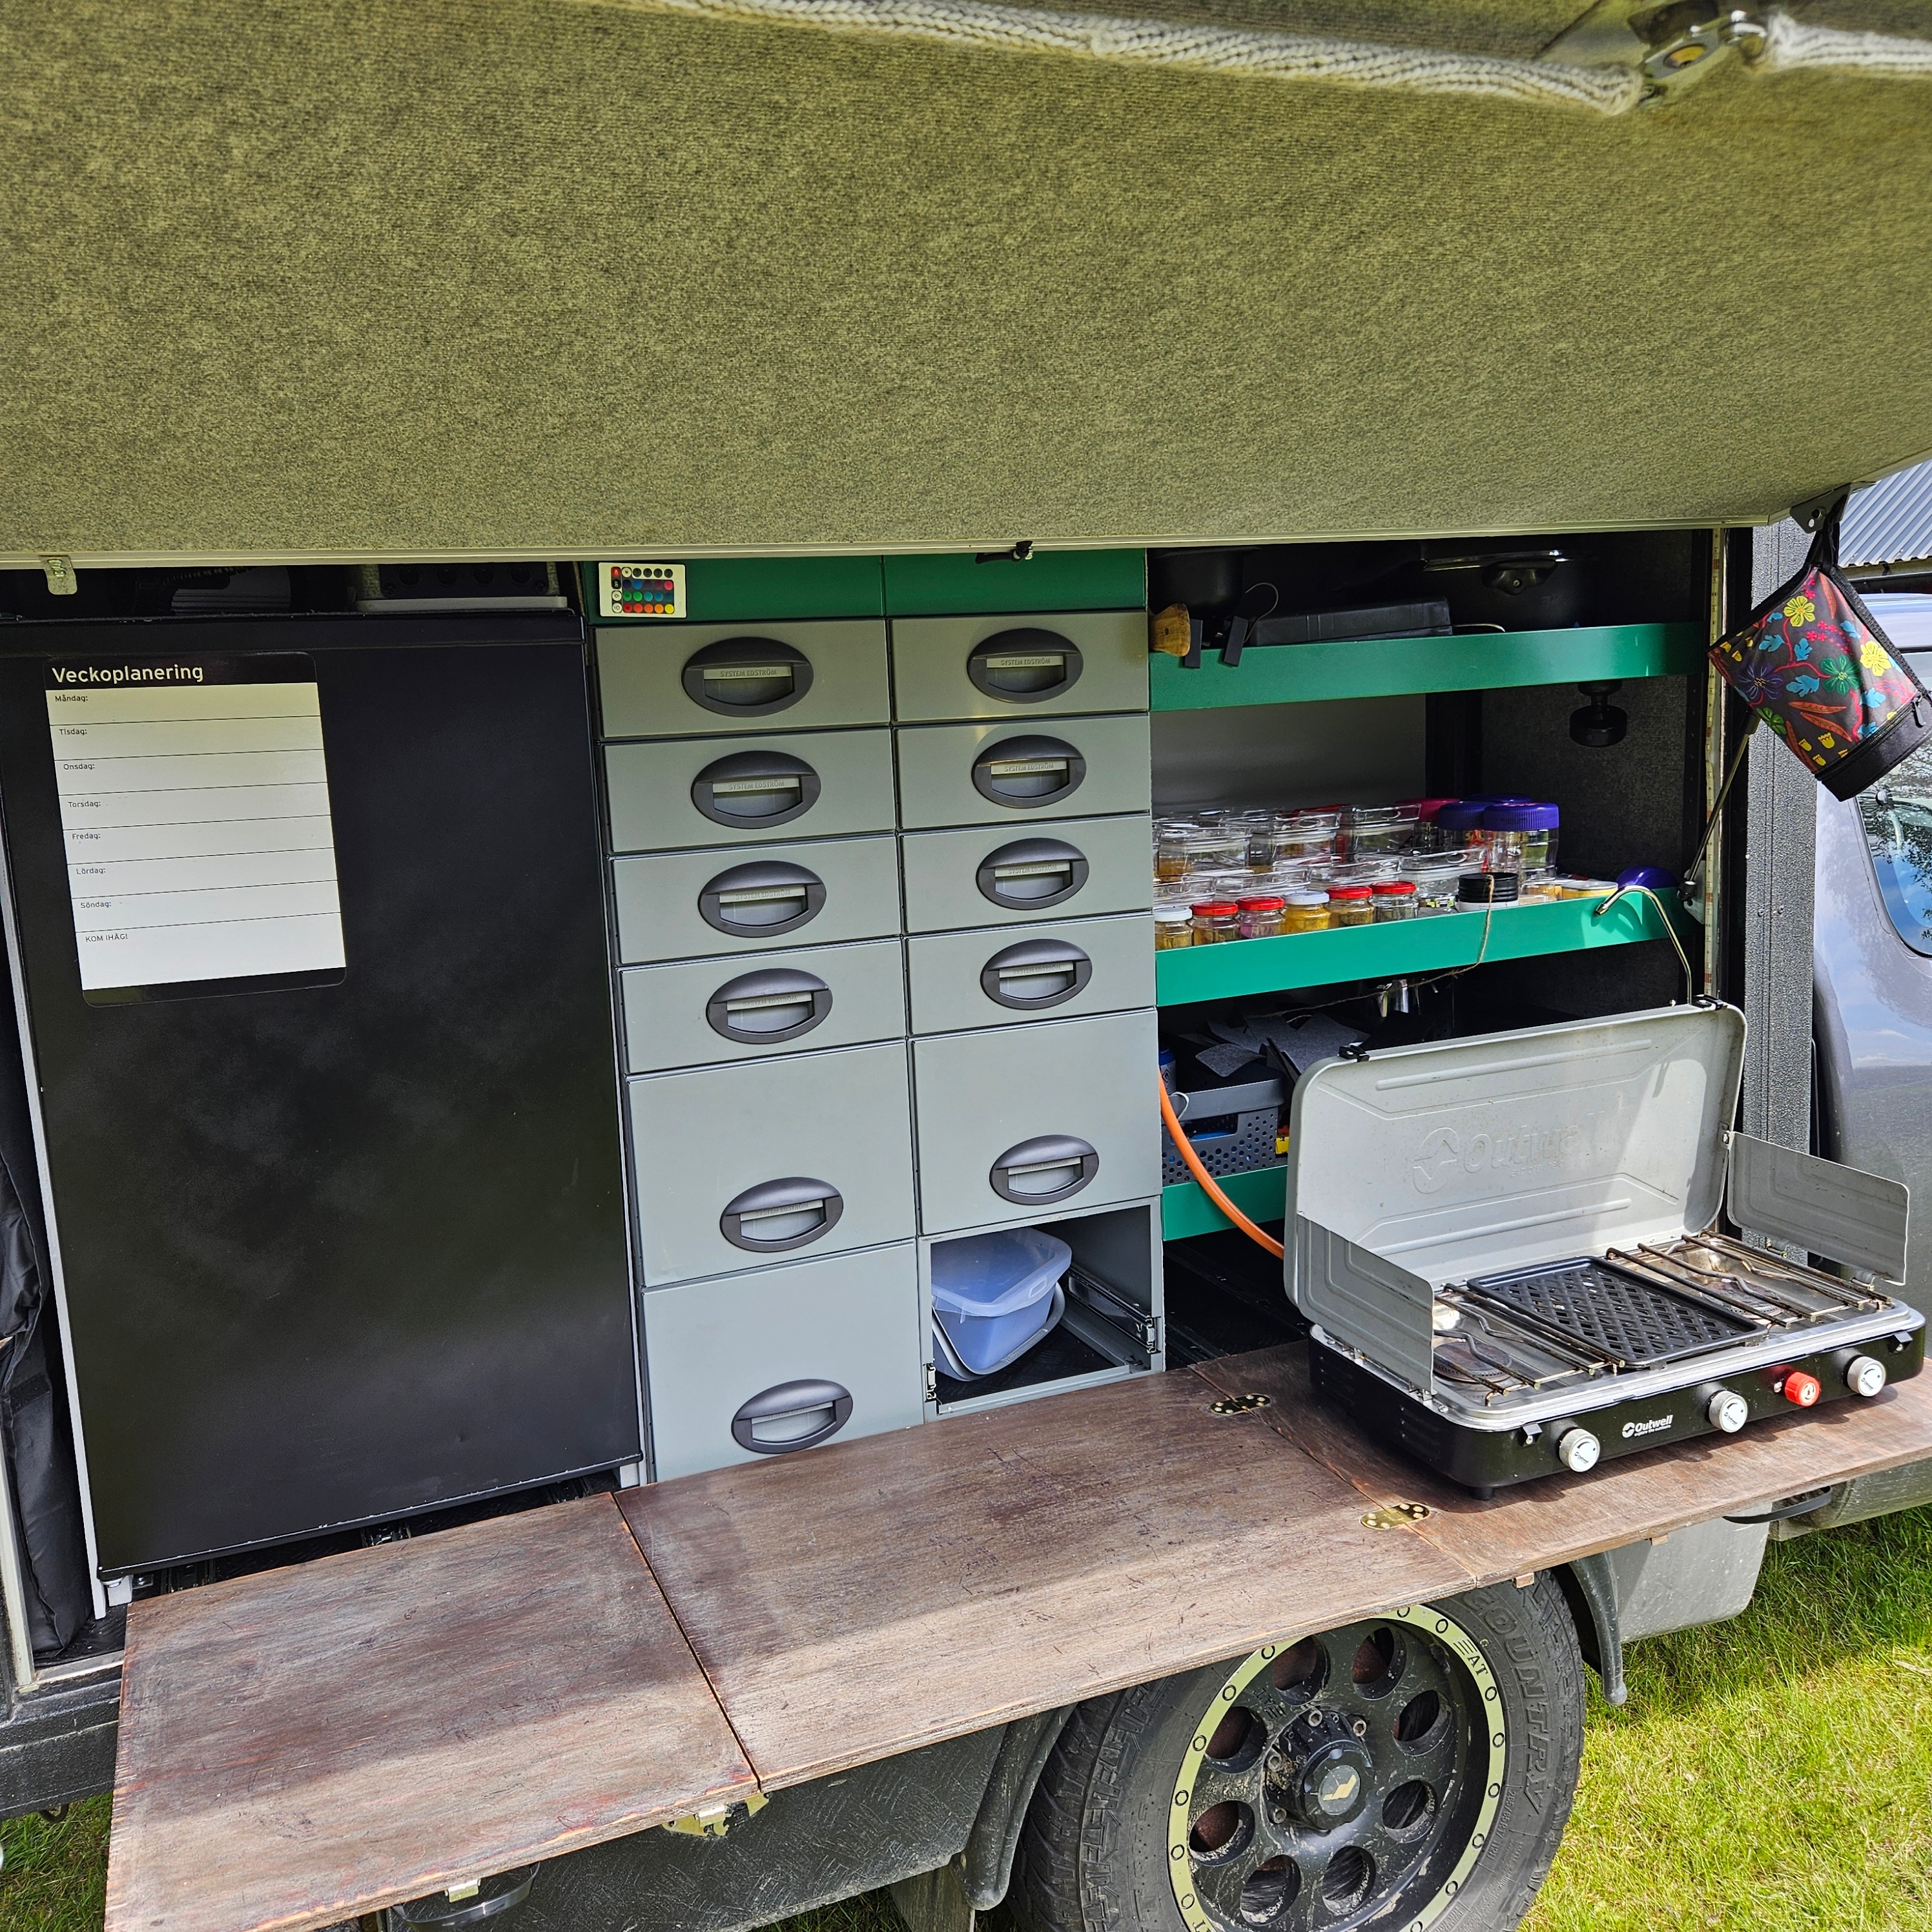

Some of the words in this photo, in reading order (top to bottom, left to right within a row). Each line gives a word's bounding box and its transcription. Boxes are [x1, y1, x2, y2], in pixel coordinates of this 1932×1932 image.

[52, 664, 203, 684] Veckoplanering
[746, 668, 777, 676] EDSTRÖM
[55, 694, 88, 703] Måndag:
[1027, 762, 1054, 770] EDSTRÖM
[1635, 1415, 1673, 1432] Outwell
